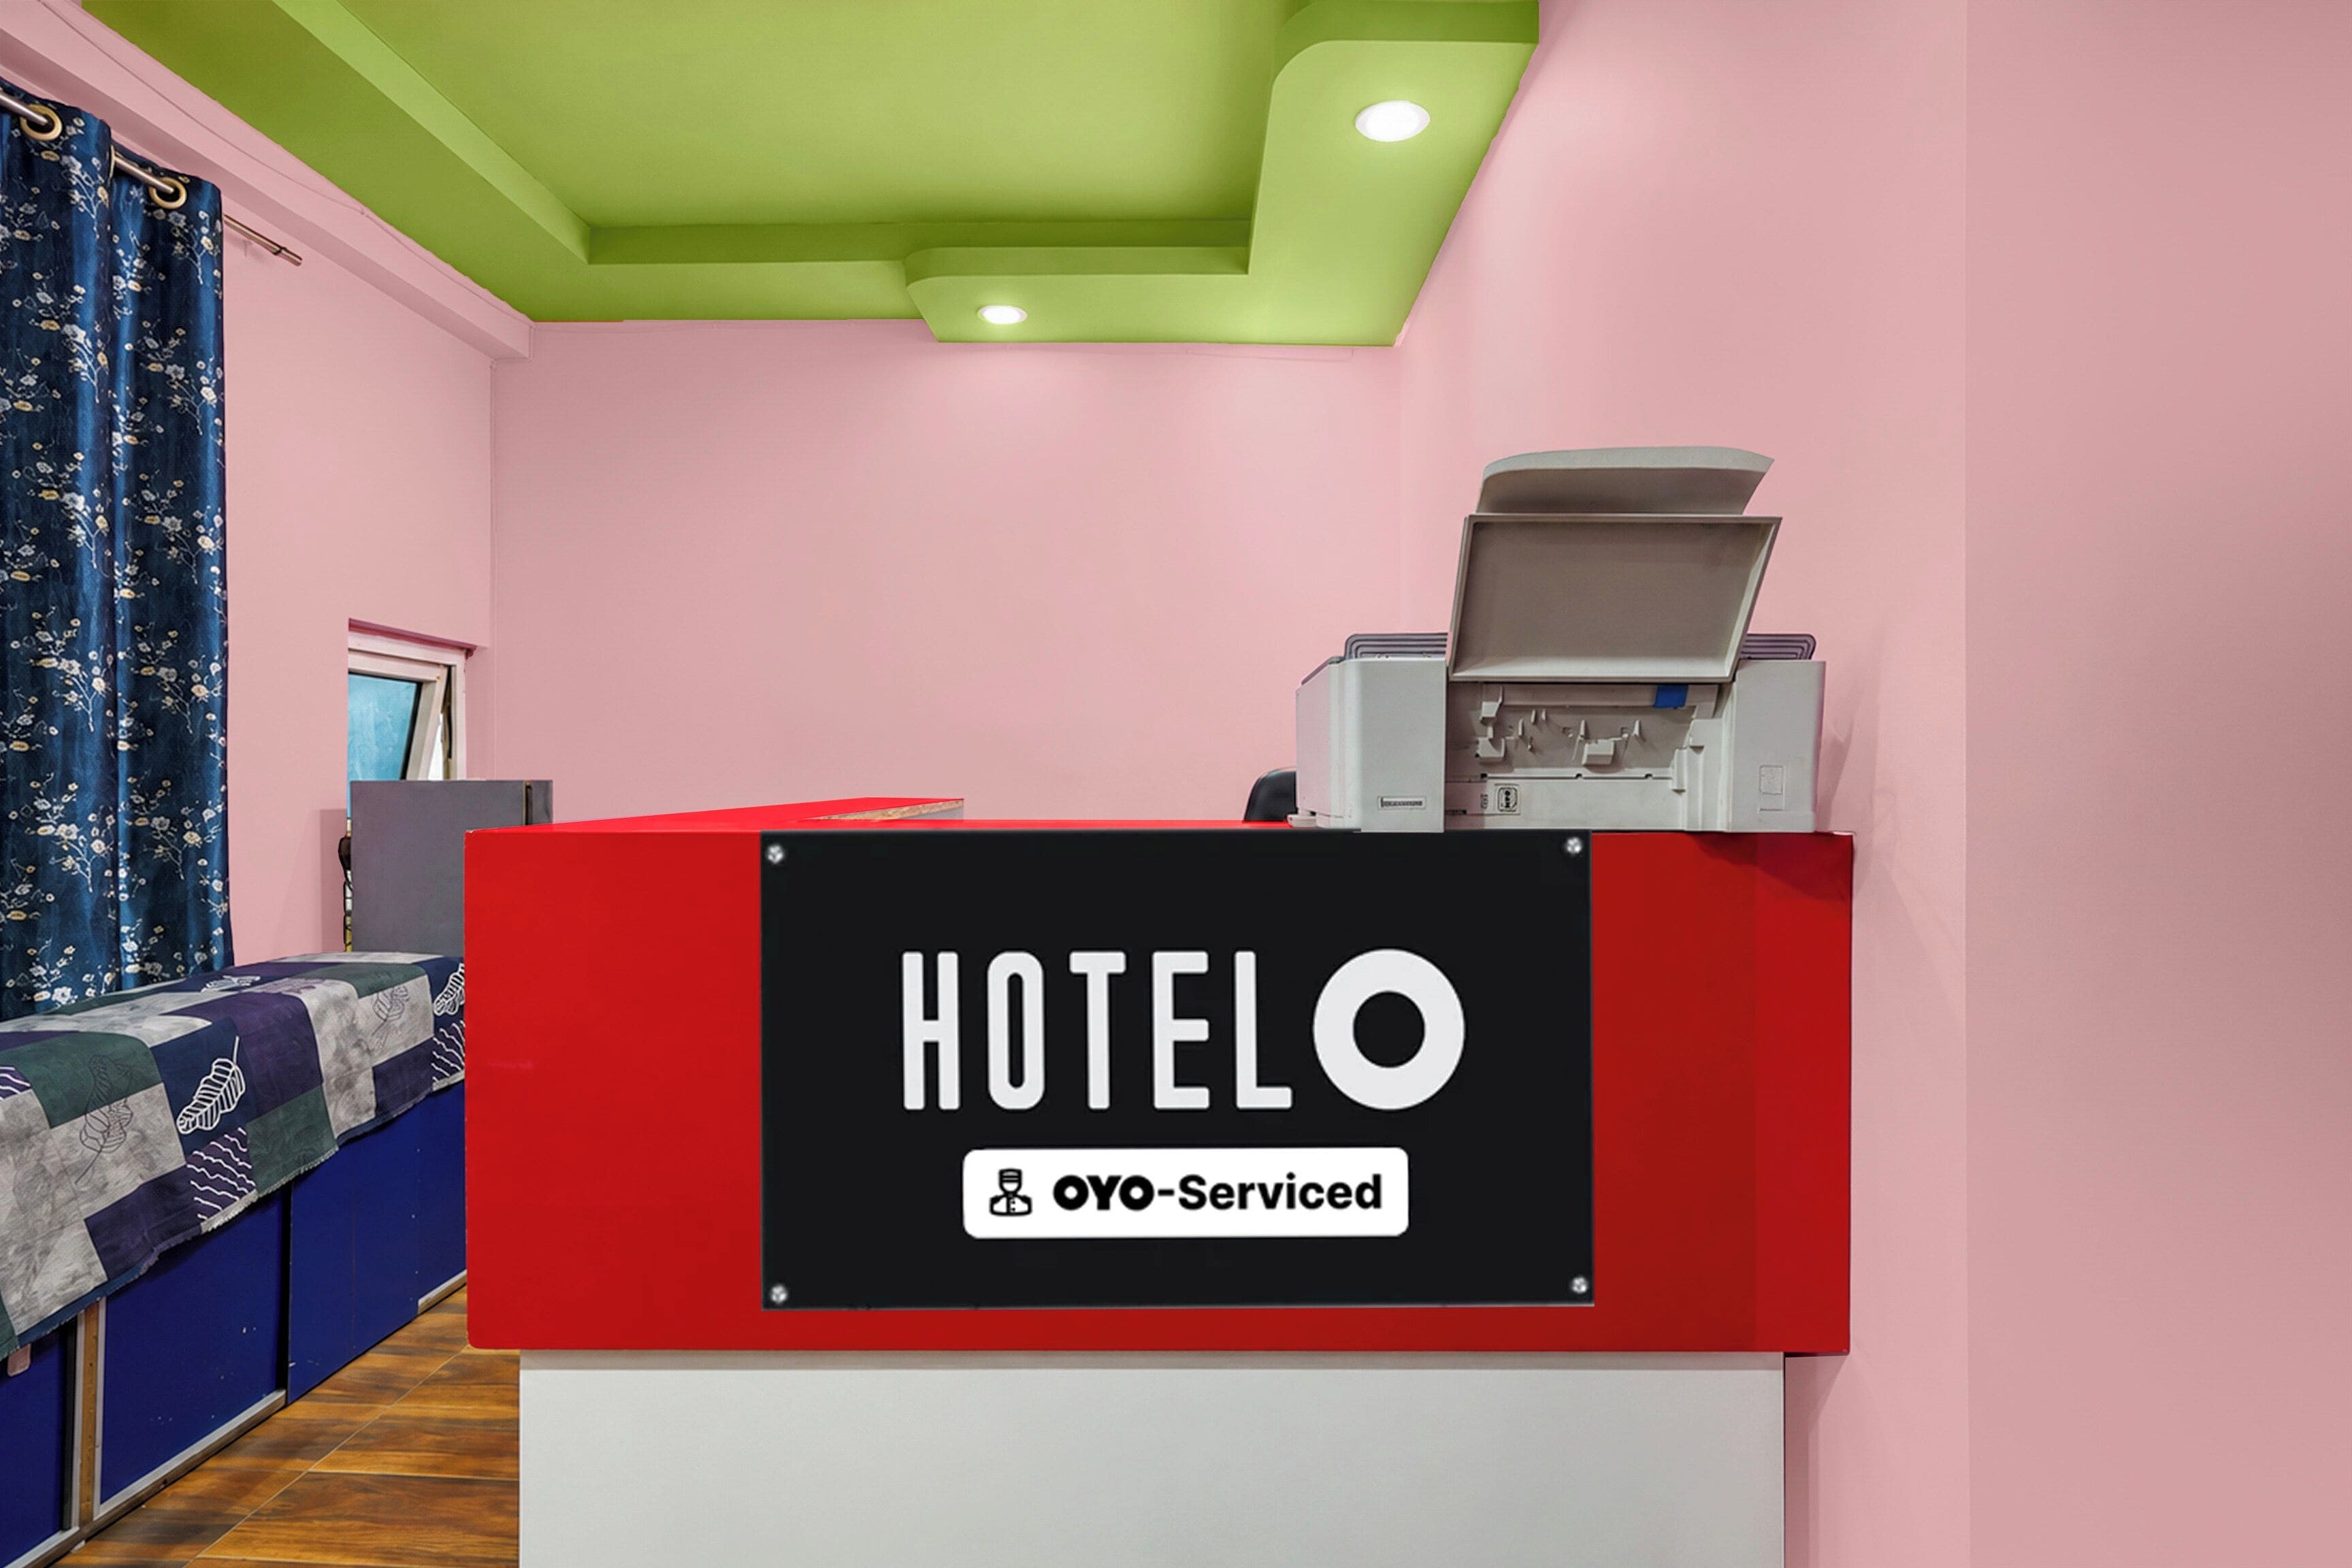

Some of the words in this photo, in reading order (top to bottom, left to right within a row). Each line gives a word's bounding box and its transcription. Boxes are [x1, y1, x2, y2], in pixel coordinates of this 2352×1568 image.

[902, 951, 1292, 1110] HOTEL
[1313, 949, 1465, 1110] O
[1053, 1172, 1382, 1211] OYO-Serviced
